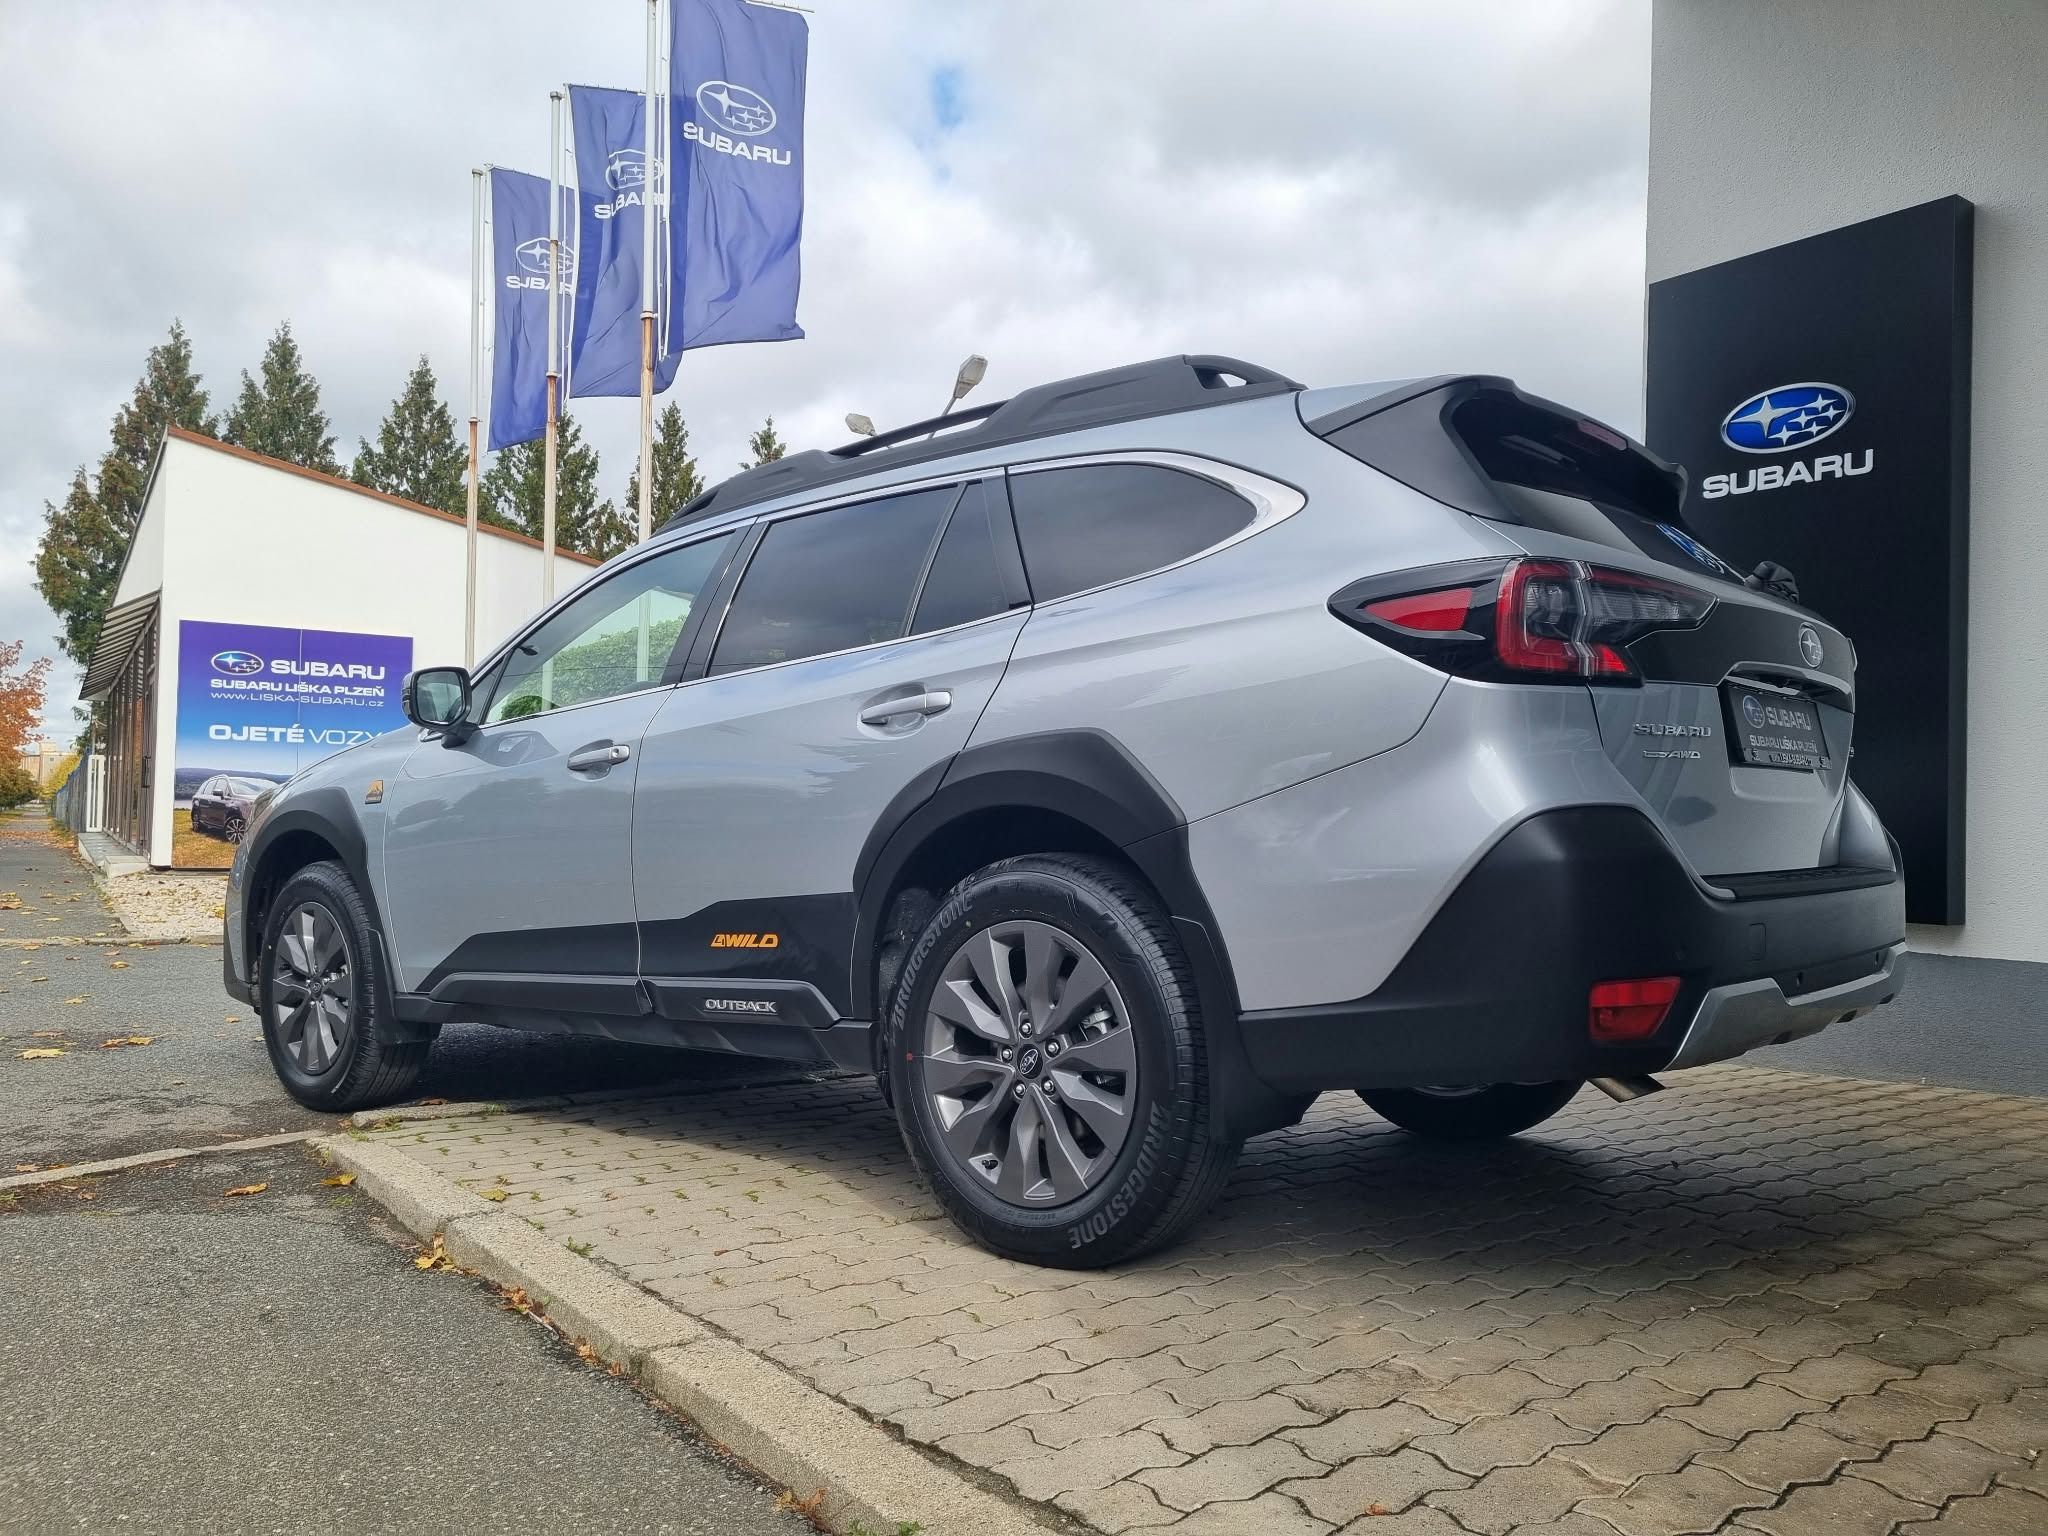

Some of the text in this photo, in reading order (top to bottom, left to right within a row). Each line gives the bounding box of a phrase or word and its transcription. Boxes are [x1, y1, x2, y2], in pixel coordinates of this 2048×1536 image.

[683, 122, 791, 165] SUBARU
[1703, 449, 1873, 499] SUBARU
[270, 659, 385, 680] SUBARU
[210, 679, 385, 697] SUBARU LIŠKA PLZEŇ
[1633, 723, 1712, 737] SUBARU
[1765, 706, 1812, 731] SUBARU
[209, 723, 305, 743] OJETÉ
[895, 889, 974, 1031] BRIDGESTONE
[704, 998, 777, 1013] OUTBACK
[1068, 1099, 1169, 1249] BRIDGESTONE
